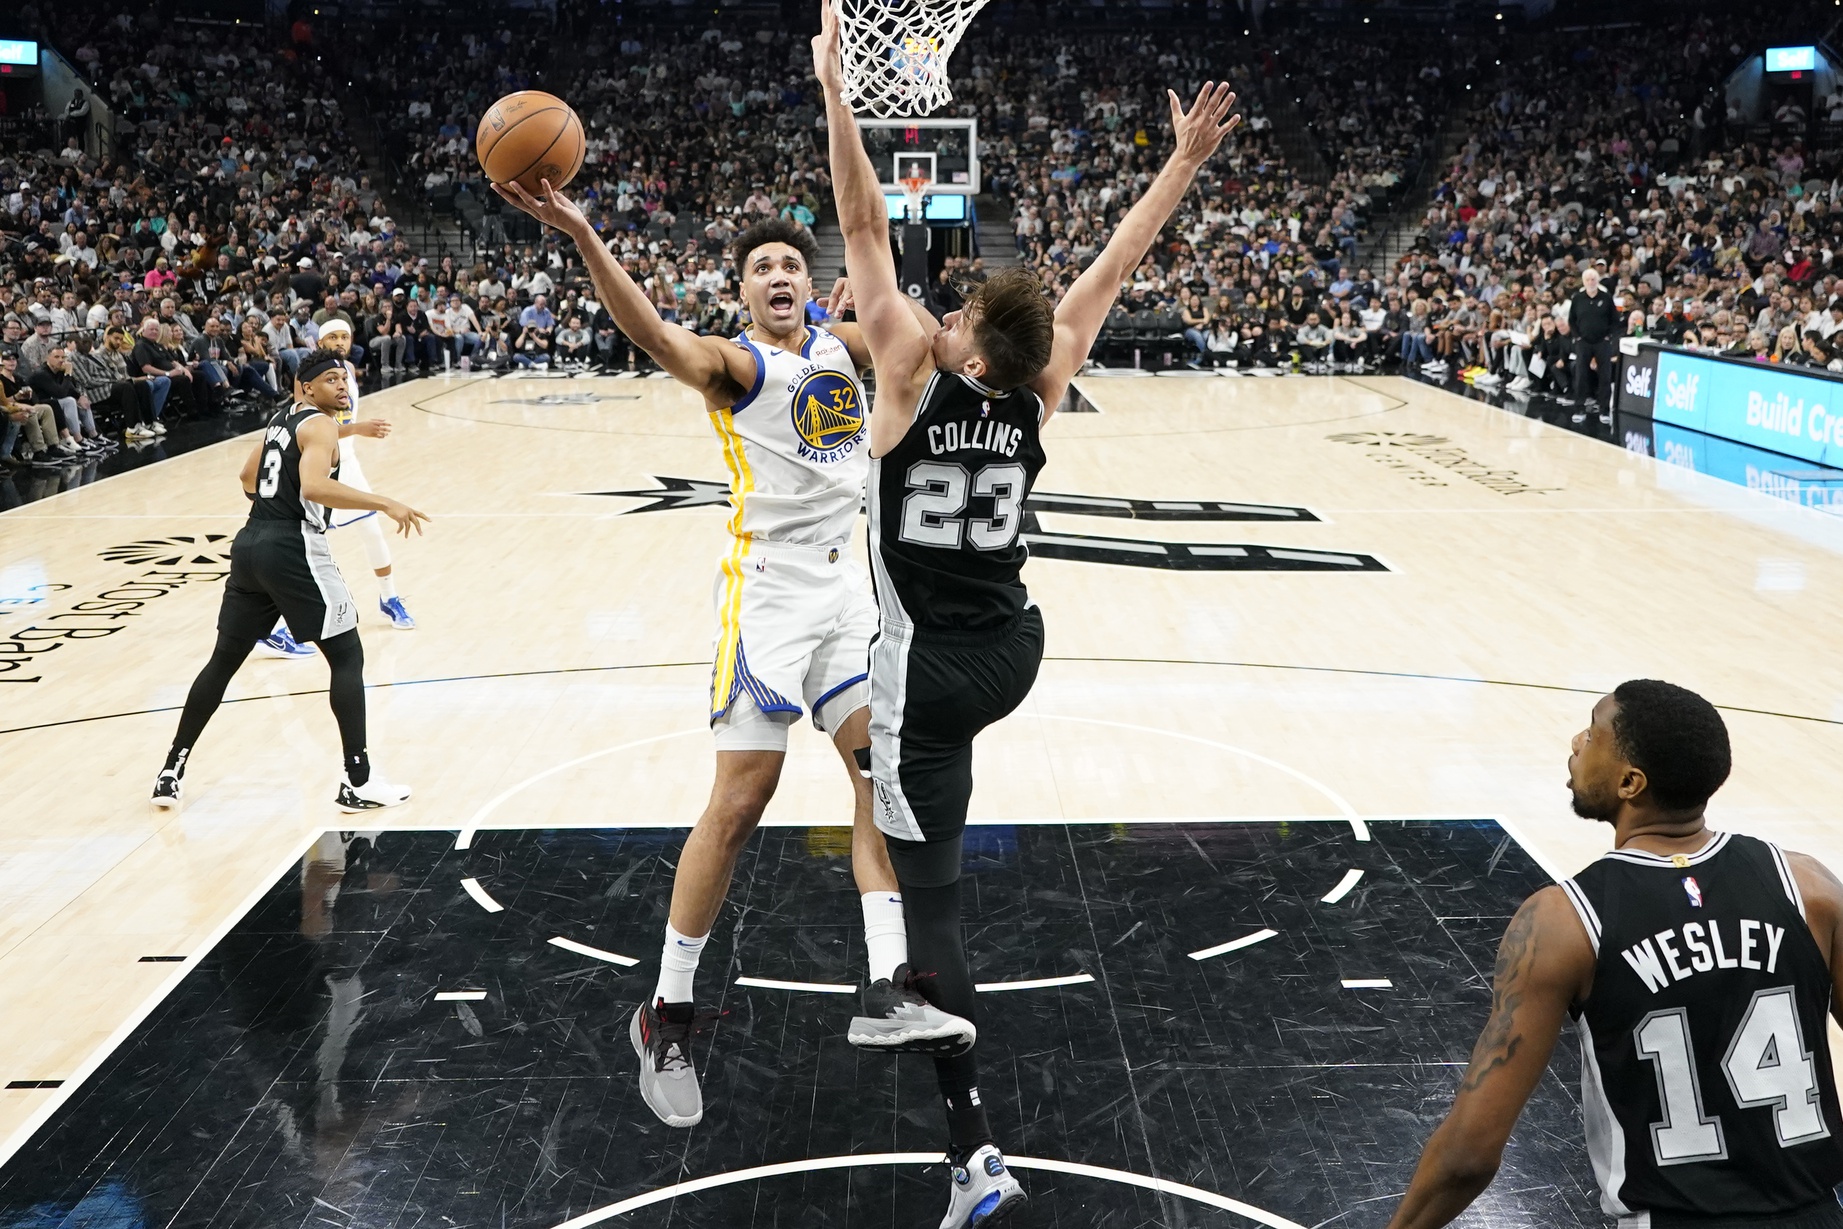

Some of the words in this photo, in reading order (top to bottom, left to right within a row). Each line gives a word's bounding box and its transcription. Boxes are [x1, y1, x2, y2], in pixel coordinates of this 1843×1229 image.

[0, 43, 23, 61] elf
[1778, 50, 1809, 68] Self
[829, 386, 856, 411] 32
[1665, 370, 1700, 412] Self
[1746, 390, 1804, 437] Build
[797, 427, 867, 463] WARRIORS
[927, 420, 1023, 458] COLLINS
[259, 449, 282, 498] 3
[898, 459, 1027, 552] 23
[47, 570, 231, 620] Frost
[1620, 919, 1785, 994] WESLEY
[1633, 985, 1831, 1166] 14
